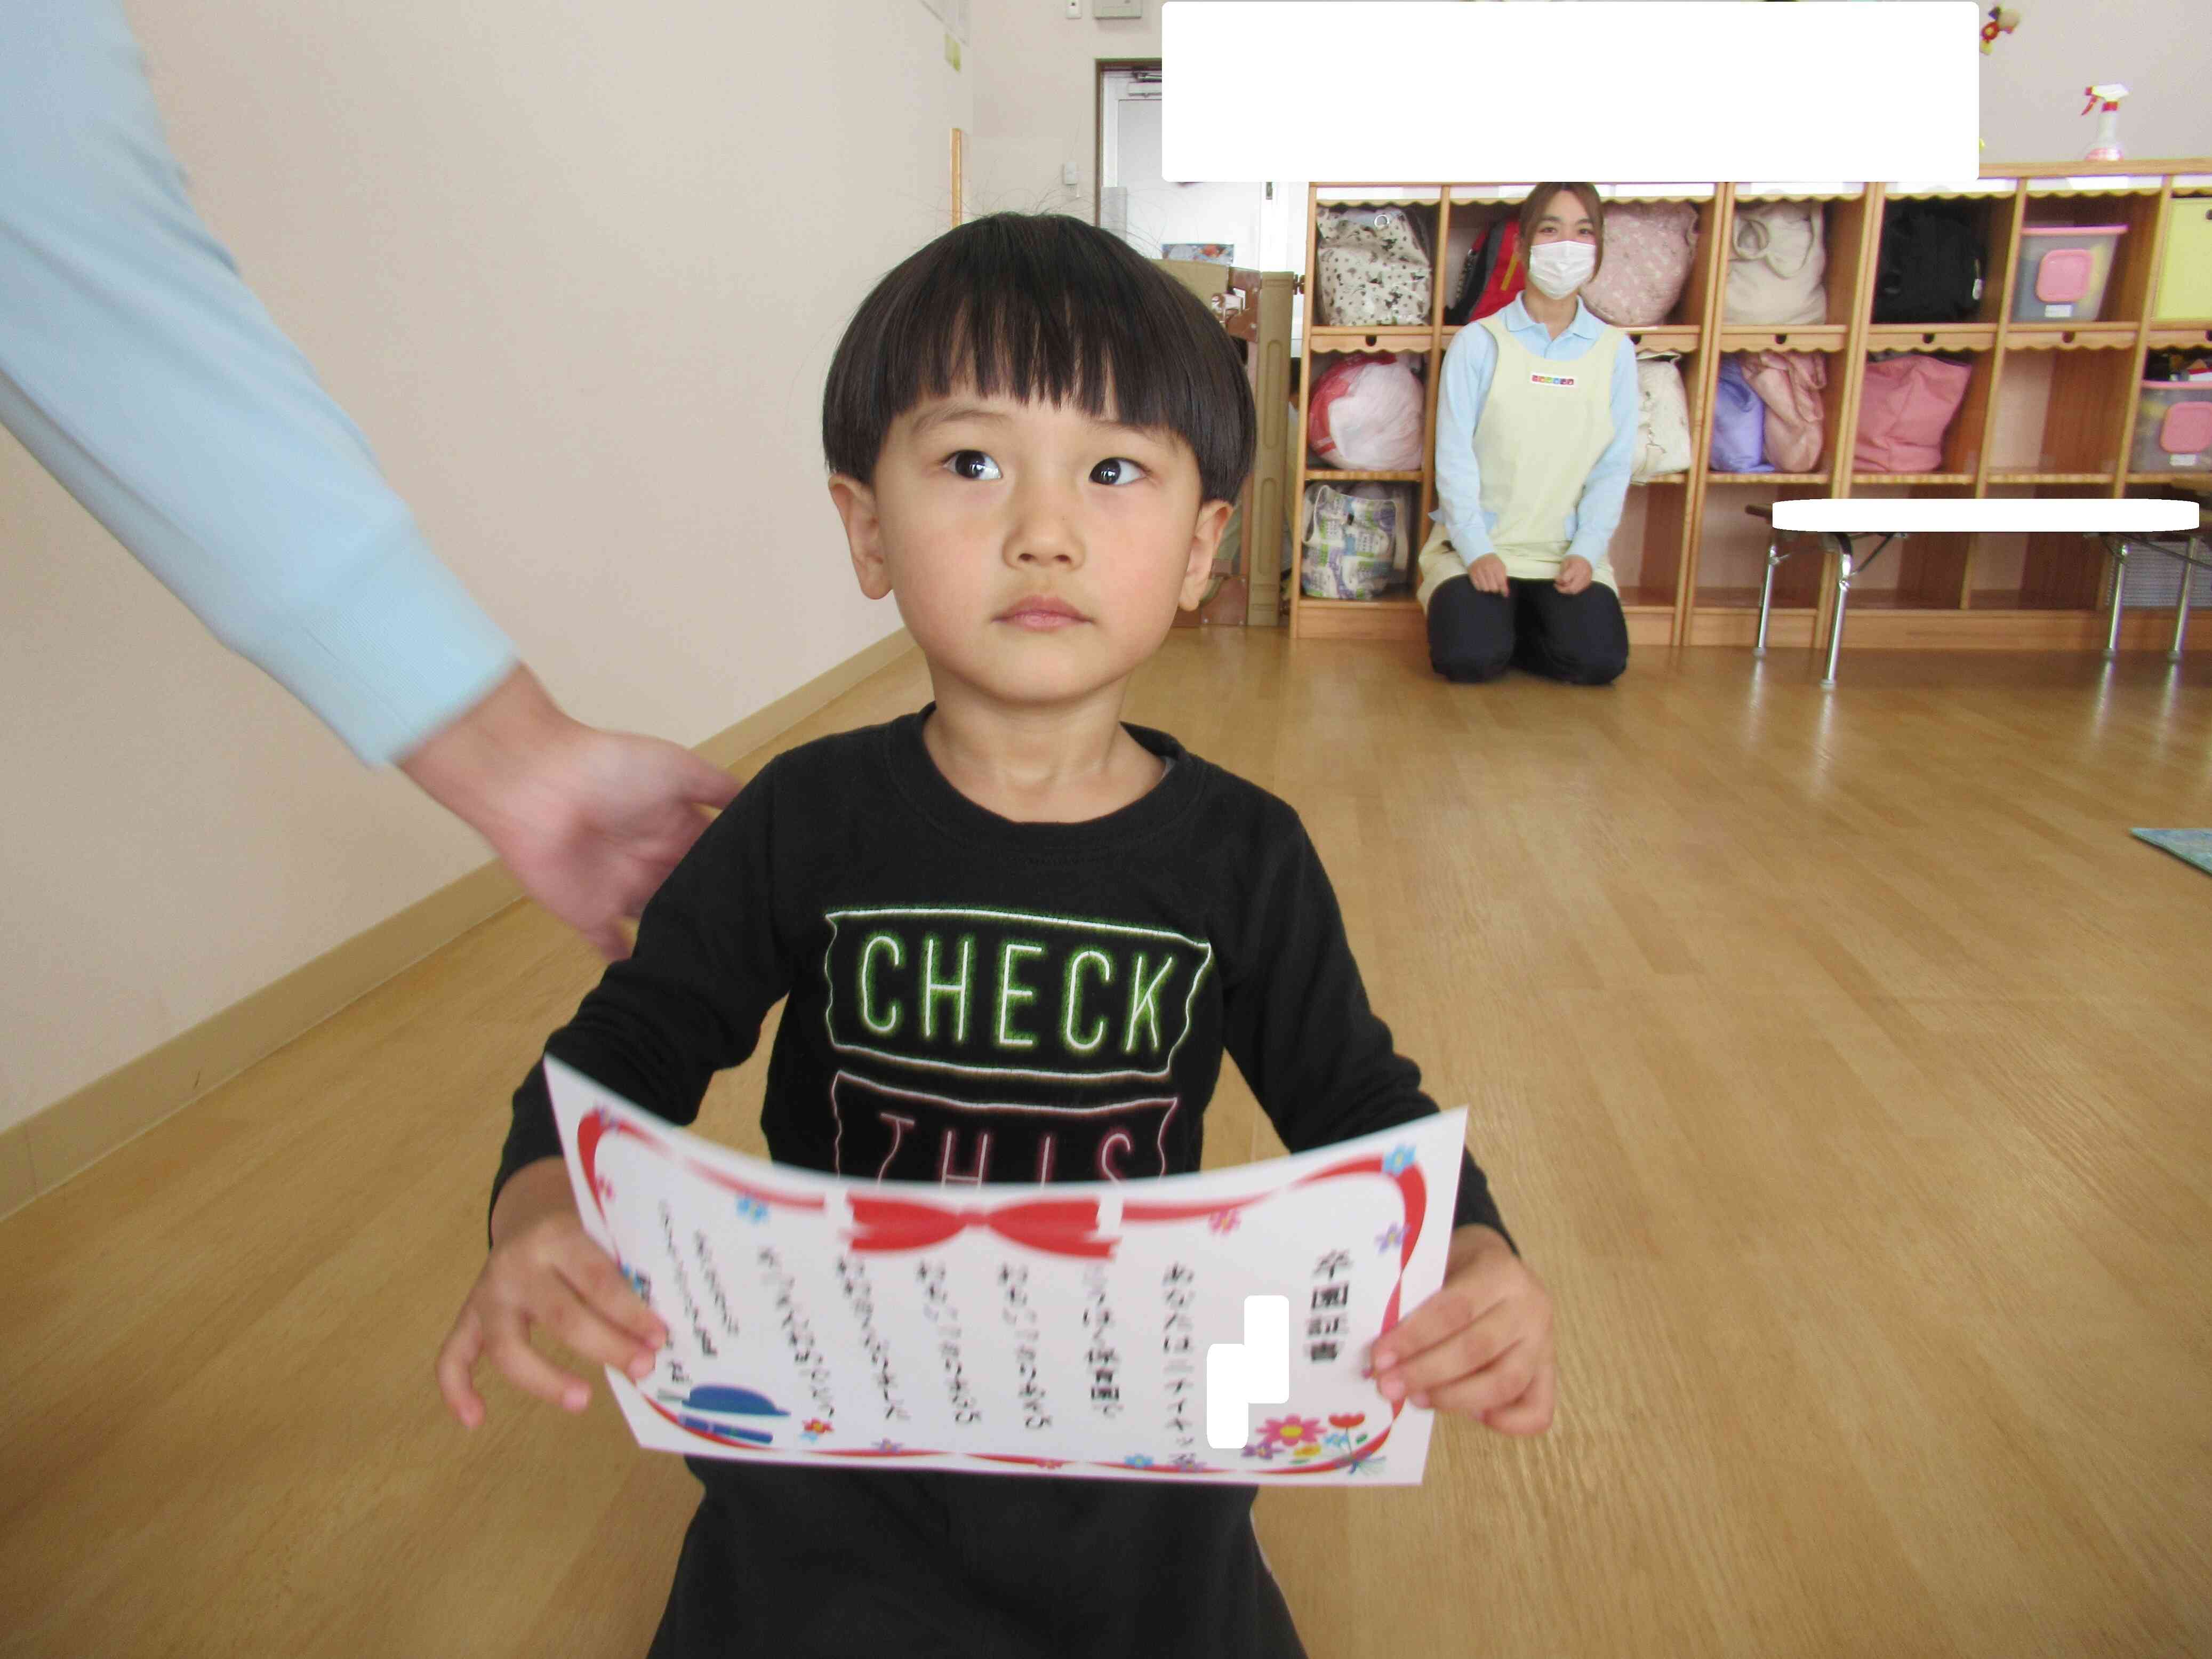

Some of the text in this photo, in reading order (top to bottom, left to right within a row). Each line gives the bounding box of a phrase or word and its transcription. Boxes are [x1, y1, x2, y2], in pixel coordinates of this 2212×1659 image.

[859, 933, 1176, 1054] CHECK
[878, 1111, 1134, 1190] THIS
[1306, 1249, 1353, 1362] 卒園証書
